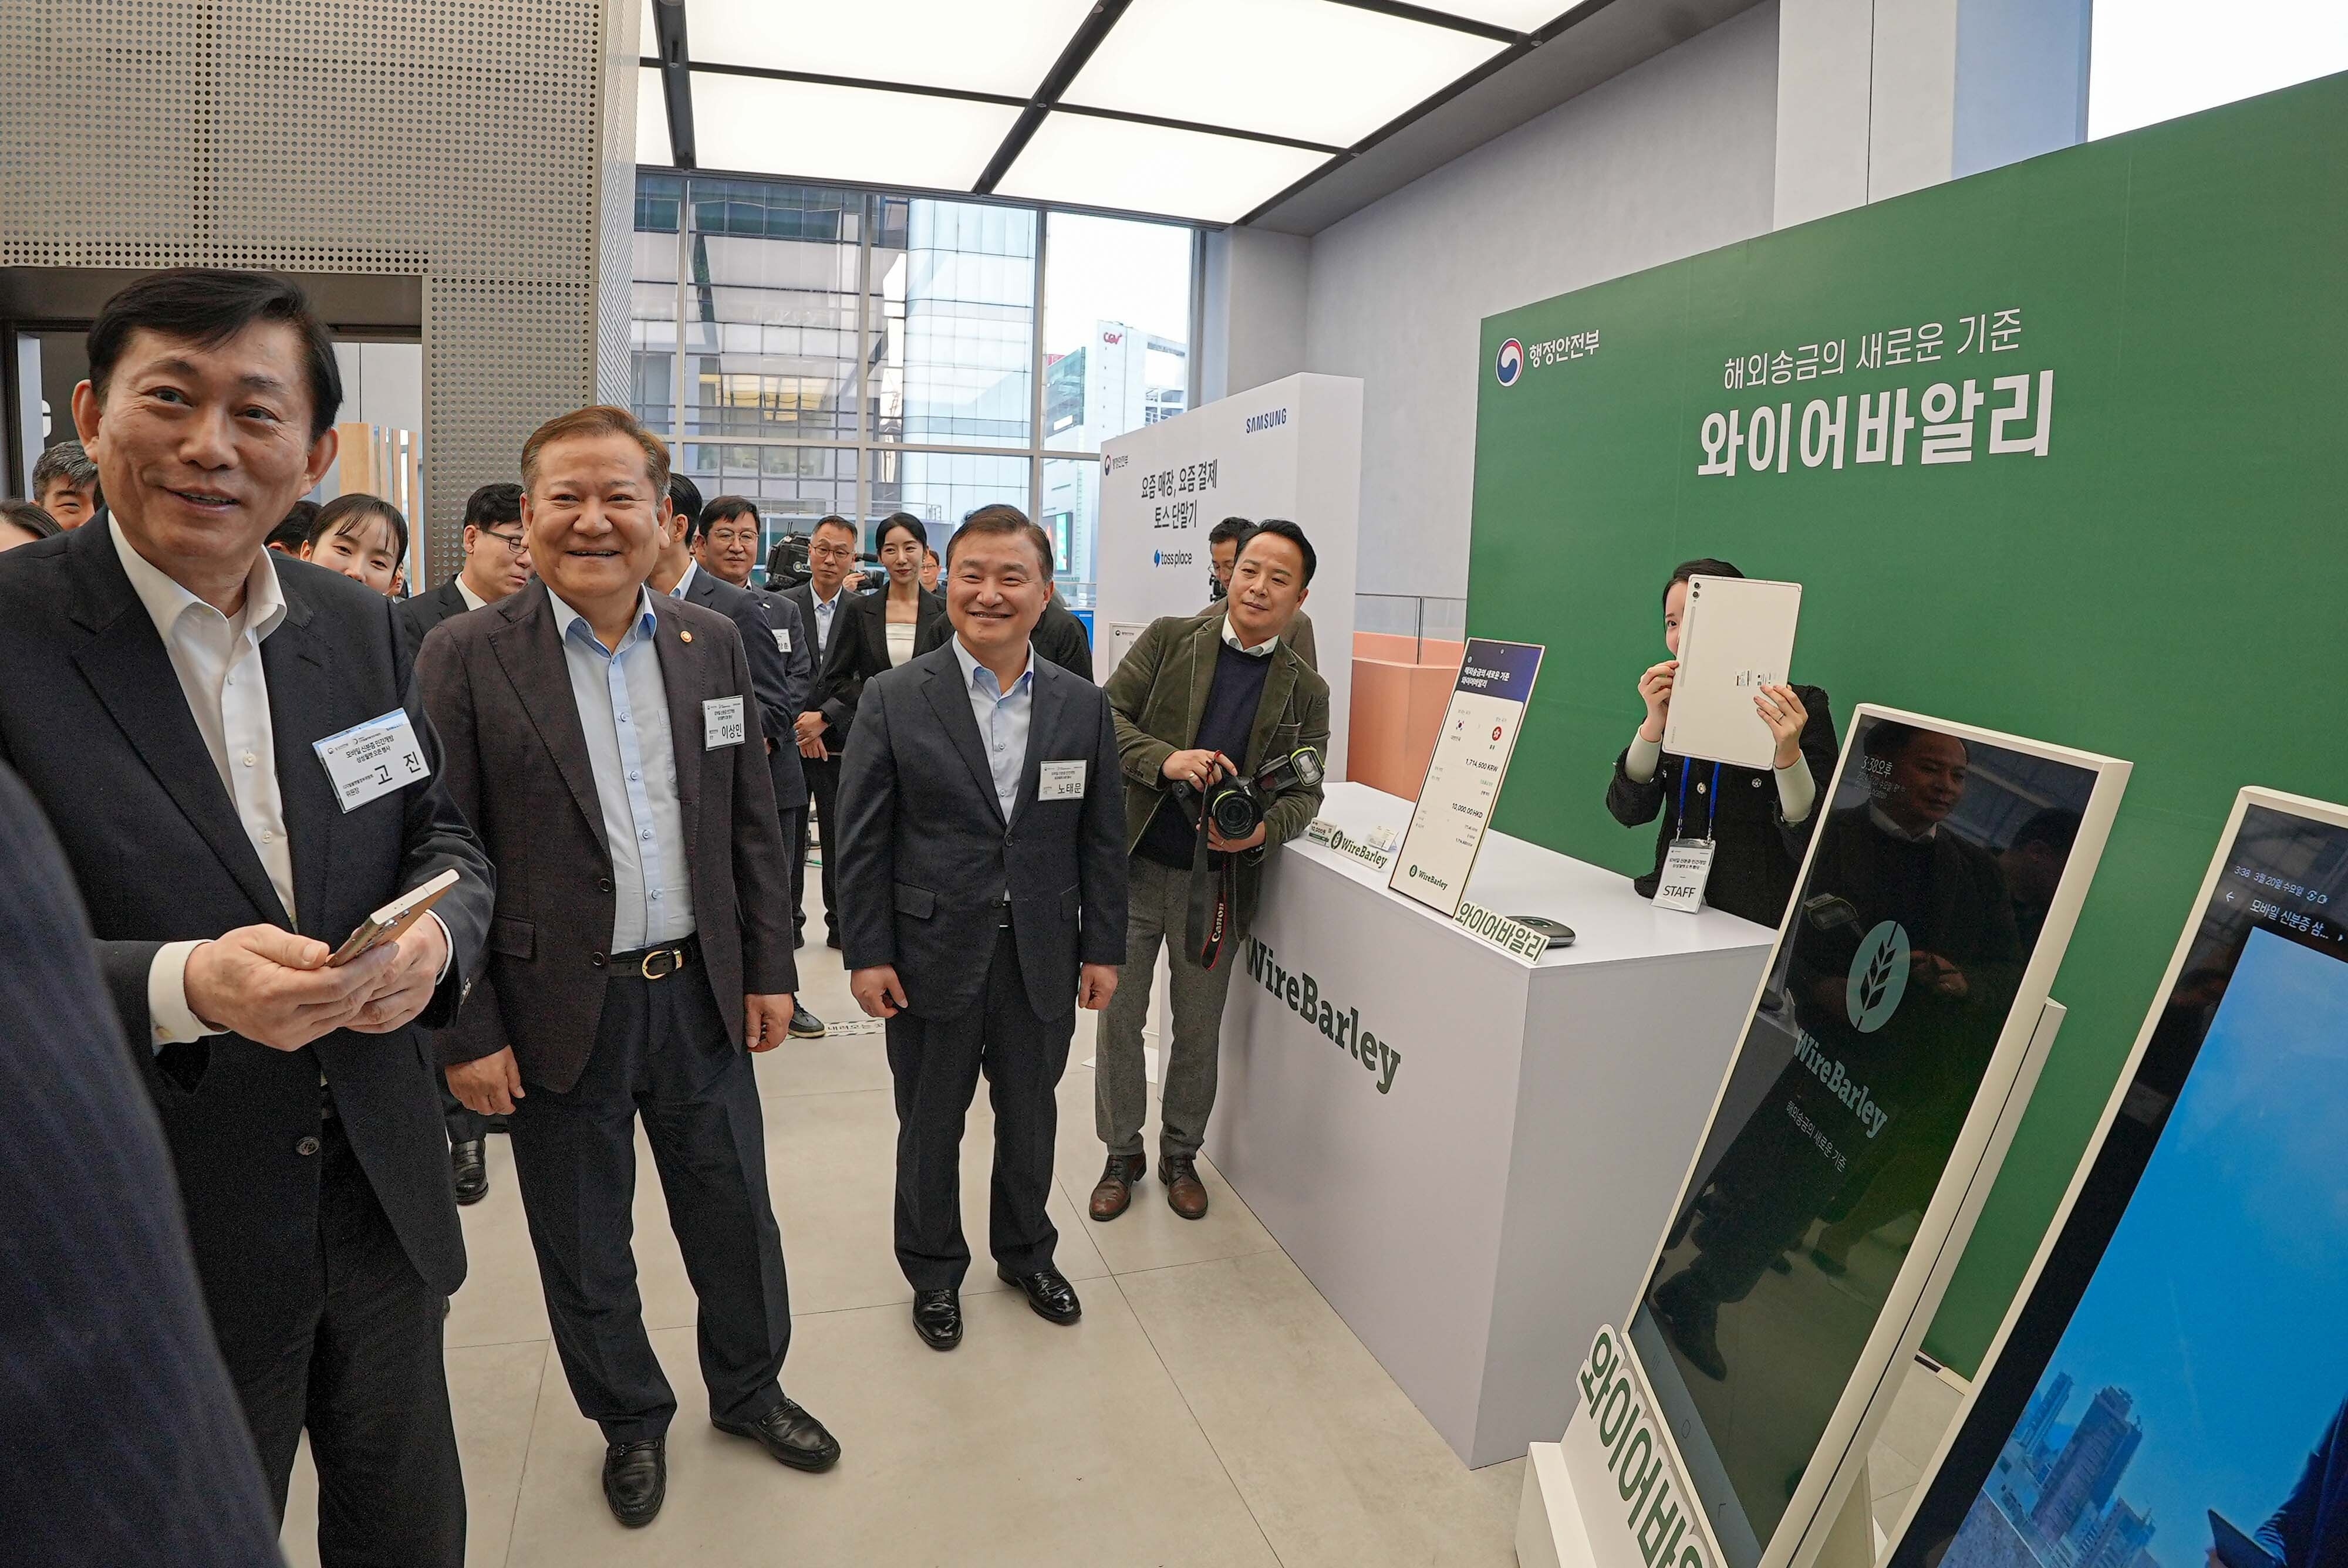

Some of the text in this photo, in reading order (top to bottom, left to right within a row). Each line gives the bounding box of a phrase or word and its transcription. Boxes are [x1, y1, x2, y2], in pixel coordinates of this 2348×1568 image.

[1529, 329, 1600, 366] 행정안전부
[1723, 308, 2021, 391] 해외송금의 새로운 기준
[1246, 408, 1287, 433] SAMSUNG
[1697, 370, 2054, 477] 와이어바알리
[1141, 459, 1217, 499] 요즘 매장, 요즘 결제
[1154, 499, 1197, 529] 토스 단말기
[1500, 672, 1510, 681] 기준
[722, 723, 741, 739] 이상민
[375, 751, 421, 785] 고 진
[1487, 764, 1499, 772] KRW
[1058, 783, 1081, 794] 노태문
[1473, 809, 1483, 818] HKD
[1341, 838, 1388, 869] WireBarley
[1418, 870, 1448, 890] WireBarley
[1663, 886, 1696, 898] STAFF
[2234, 866, 2305, 897] 3:38 3월 20일 수요일
[1212, 903, 1224, 942] Canon
[2250, 899, 2280, 921] 모바일
[2280, 910, 2312, 932] 신분증
[1455, 903, 1547, 962] 와이어바알리
[1246, 934, 1401, 1094] WireBarley
[1794, 1028, 1888, 1138] WireBarley
[1786, 1100, 1847, 1172] 해외송금의 새로운 기준
